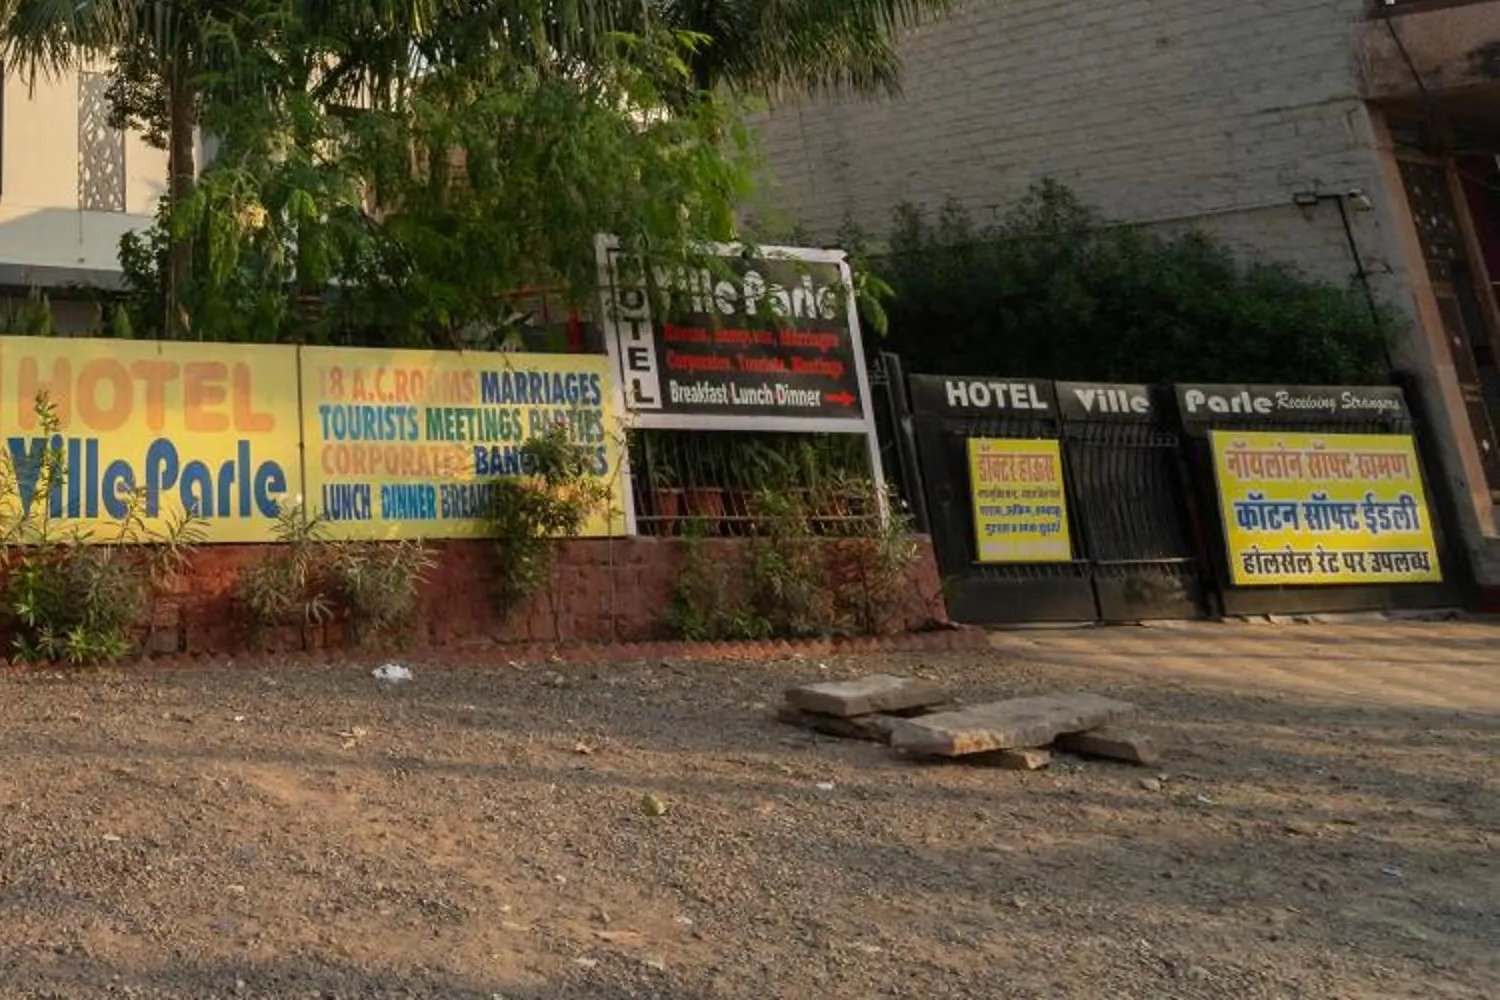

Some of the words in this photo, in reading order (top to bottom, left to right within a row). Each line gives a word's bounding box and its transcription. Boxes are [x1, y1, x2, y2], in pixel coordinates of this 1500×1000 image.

[17, 355, 276, 434] HOTEL
[480, 371, 602, 406] MARRIAGES
[669, 379, 729, 405] Breakfast
[730, 381, 774, 406] Lunch
[774, 383, 822, 408] Dinner
[945, 380, 1049, 410] HOTEL
[1073, 387, 1151, 414] Ville
[1184, 389, 1274, 414] Parle
[319, 404, 420, 441] TOURISTS
[425, 406, 523, 442] MEETINGS
[322, 483, 373, 520] LUNCH
[380, 483, 437, 521] DINNER
